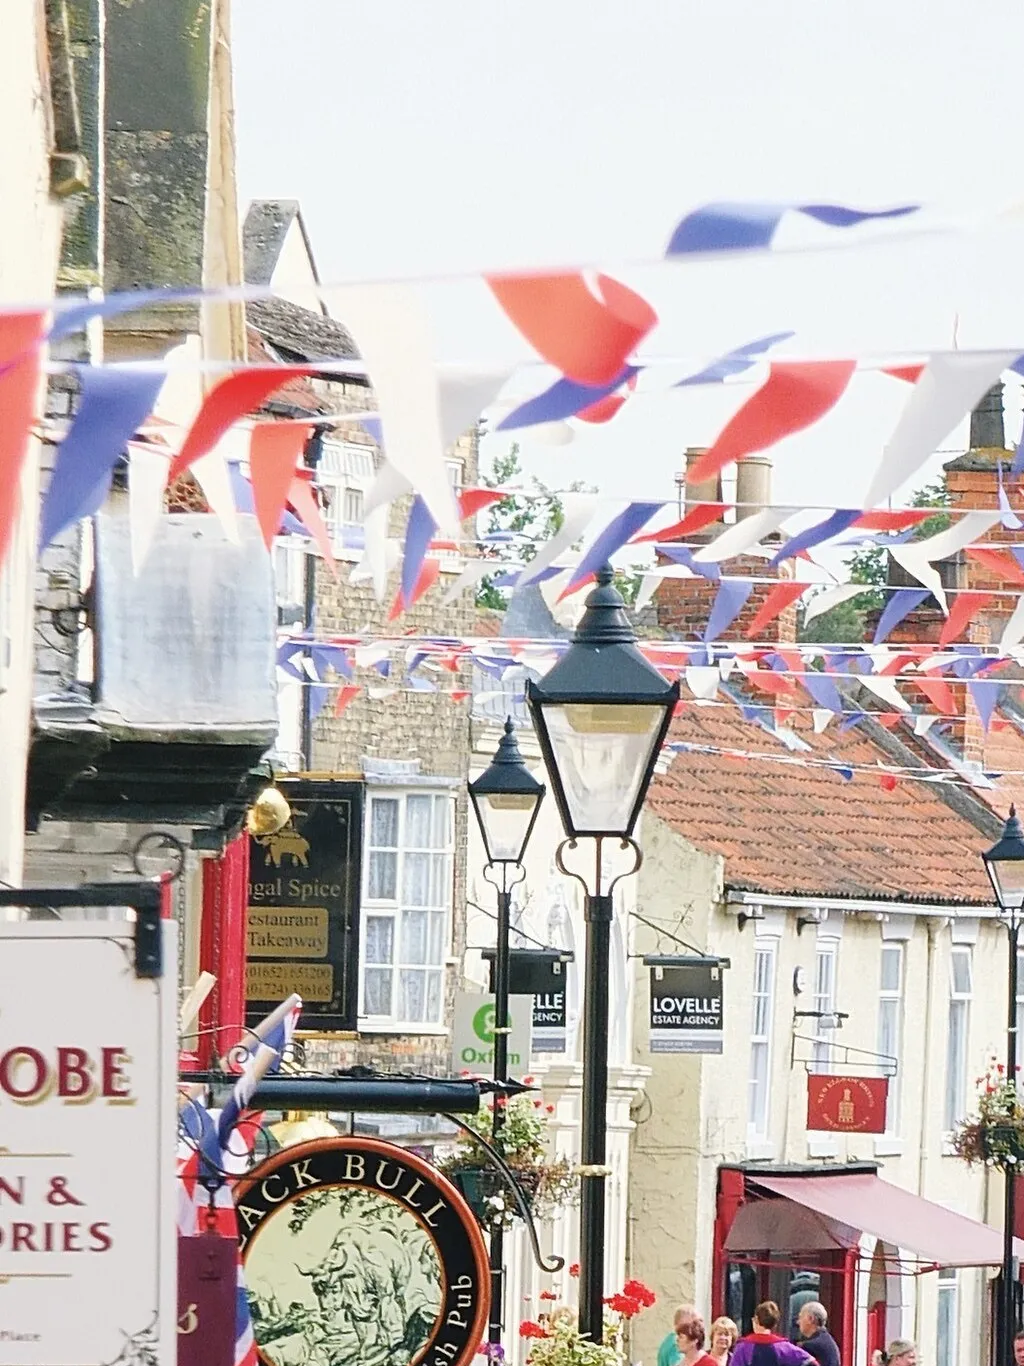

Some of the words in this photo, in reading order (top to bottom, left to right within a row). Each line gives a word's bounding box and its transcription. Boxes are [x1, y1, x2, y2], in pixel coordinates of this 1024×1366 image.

[288, 879, 340, 901] Spice
[248, 931, 325, 951] Takeaway
[653, 997, 721, 1014] LOVELLE
[652, 1015, 681, 1025] ESTATE
[682, 1015, 720, 1026] AGENCY
[461, 1047, 521, 1065] Oxfm
[47, 1176, 87, 1206] &
[341, 1153, 447, 1228] BULL
[0, 1222, 113, 1253] RIES
[448, 1274, 473, 1329] Pub
